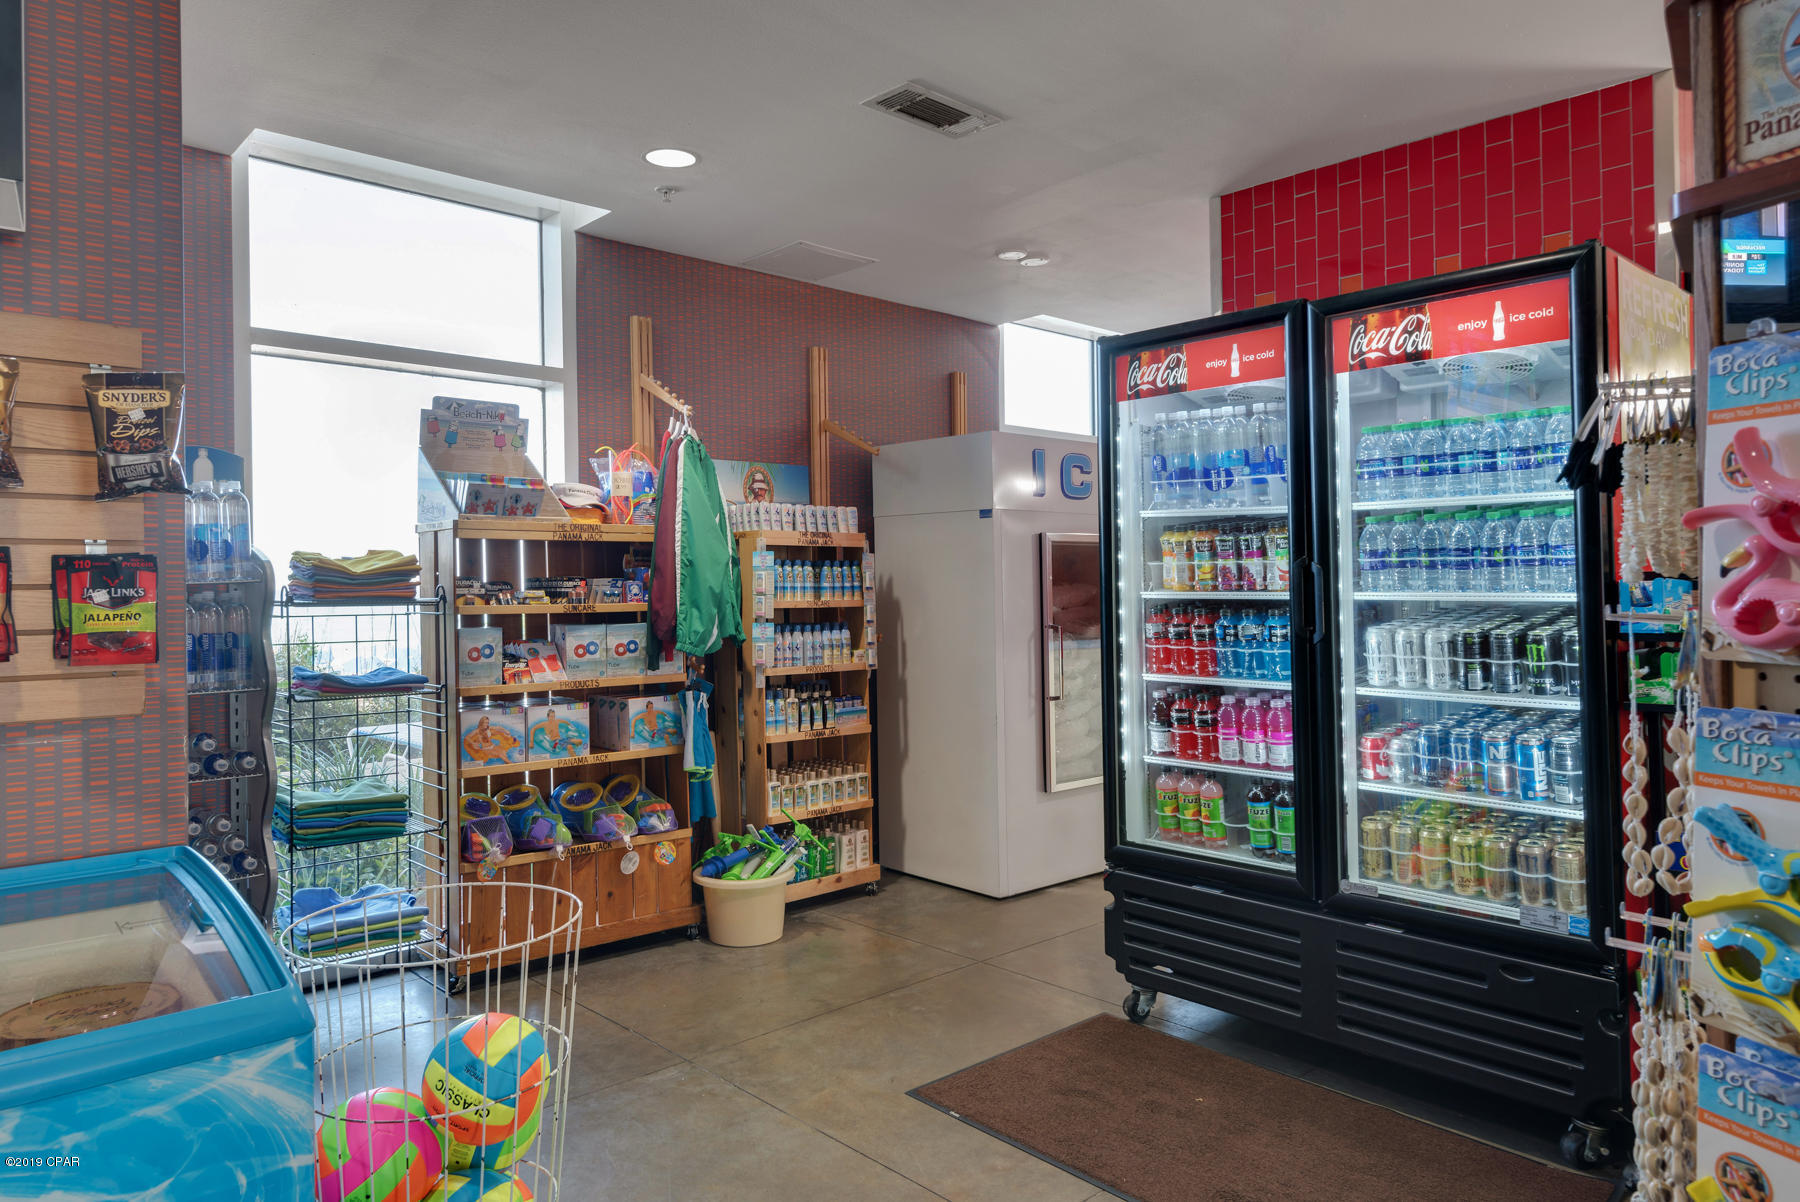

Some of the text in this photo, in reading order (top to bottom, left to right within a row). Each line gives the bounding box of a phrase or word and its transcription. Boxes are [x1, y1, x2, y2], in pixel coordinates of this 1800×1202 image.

[1622, 275, 1689, 339] REFRESH
[1457, 318, 1488, 332] enjoy
[1509, 312, 1526, 323] ice
[1528, 306, 1554, 320] cold
[1349, 313, 1433, 365] Coca-Cola
[1205, 349, 1275, 369] enjoy ice cold
[1714, 353, 1778, 376] Boca
[1127, 352, 1188, 395] Coca-Cola
[1726, 371, 1789, 399] Clips
[102, 392, 166, 403] SNYDER'S
[110, 423, 160, 441] Dips
[115, 462, 159, 479] HERSHEY'S
[552, 532, 604, 541] PANAMA JACK
[73, 560, 91, 569] 110
[562, 604, 597, 613] SUNCARE
[83, 611, 142, 625] JALAPEÑO
[559, 679, 600, 689] PRODUCTS
[1702, 717, 1772, 746] Boca
[557, 754, 610, 767] PANAMA JACK
[1712, 743, 1784, 776] Clips
[1699, 775, 1724, 786] Keeps
[1725, 778, 1744, 789] Your
[1746, 782, 1776, 794] Towels
[1249, 808, 1270, 816] FUZE
[564, 842, 613, 857] ANAMA JACK
[1717, 1085, 1790, 1129] Clips
